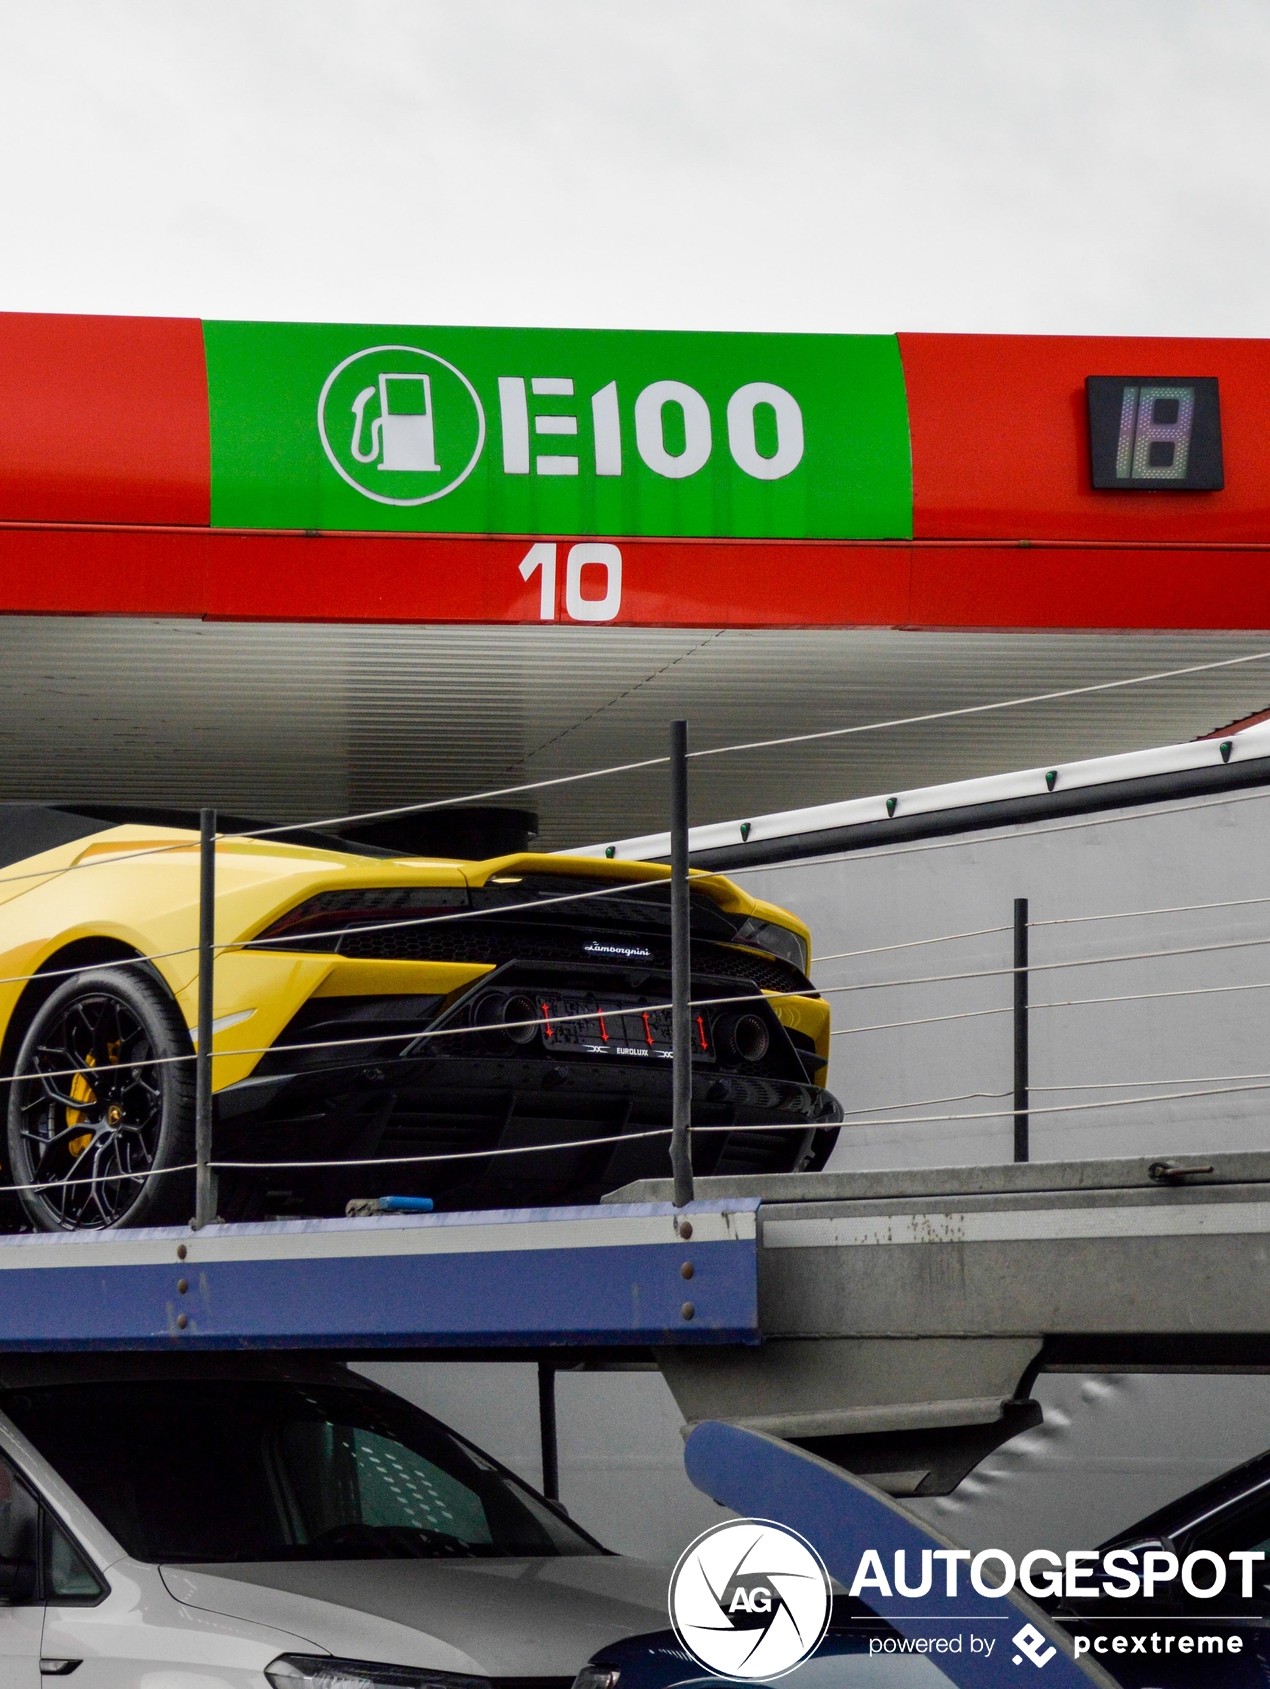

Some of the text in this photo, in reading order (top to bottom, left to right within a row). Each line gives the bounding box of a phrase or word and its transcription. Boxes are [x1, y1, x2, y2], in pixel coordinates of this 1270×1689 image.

[497, 376, 804, 480] E100
[1116, 386, 1195, 479] 18
[518, 543, 623, 621] 10
